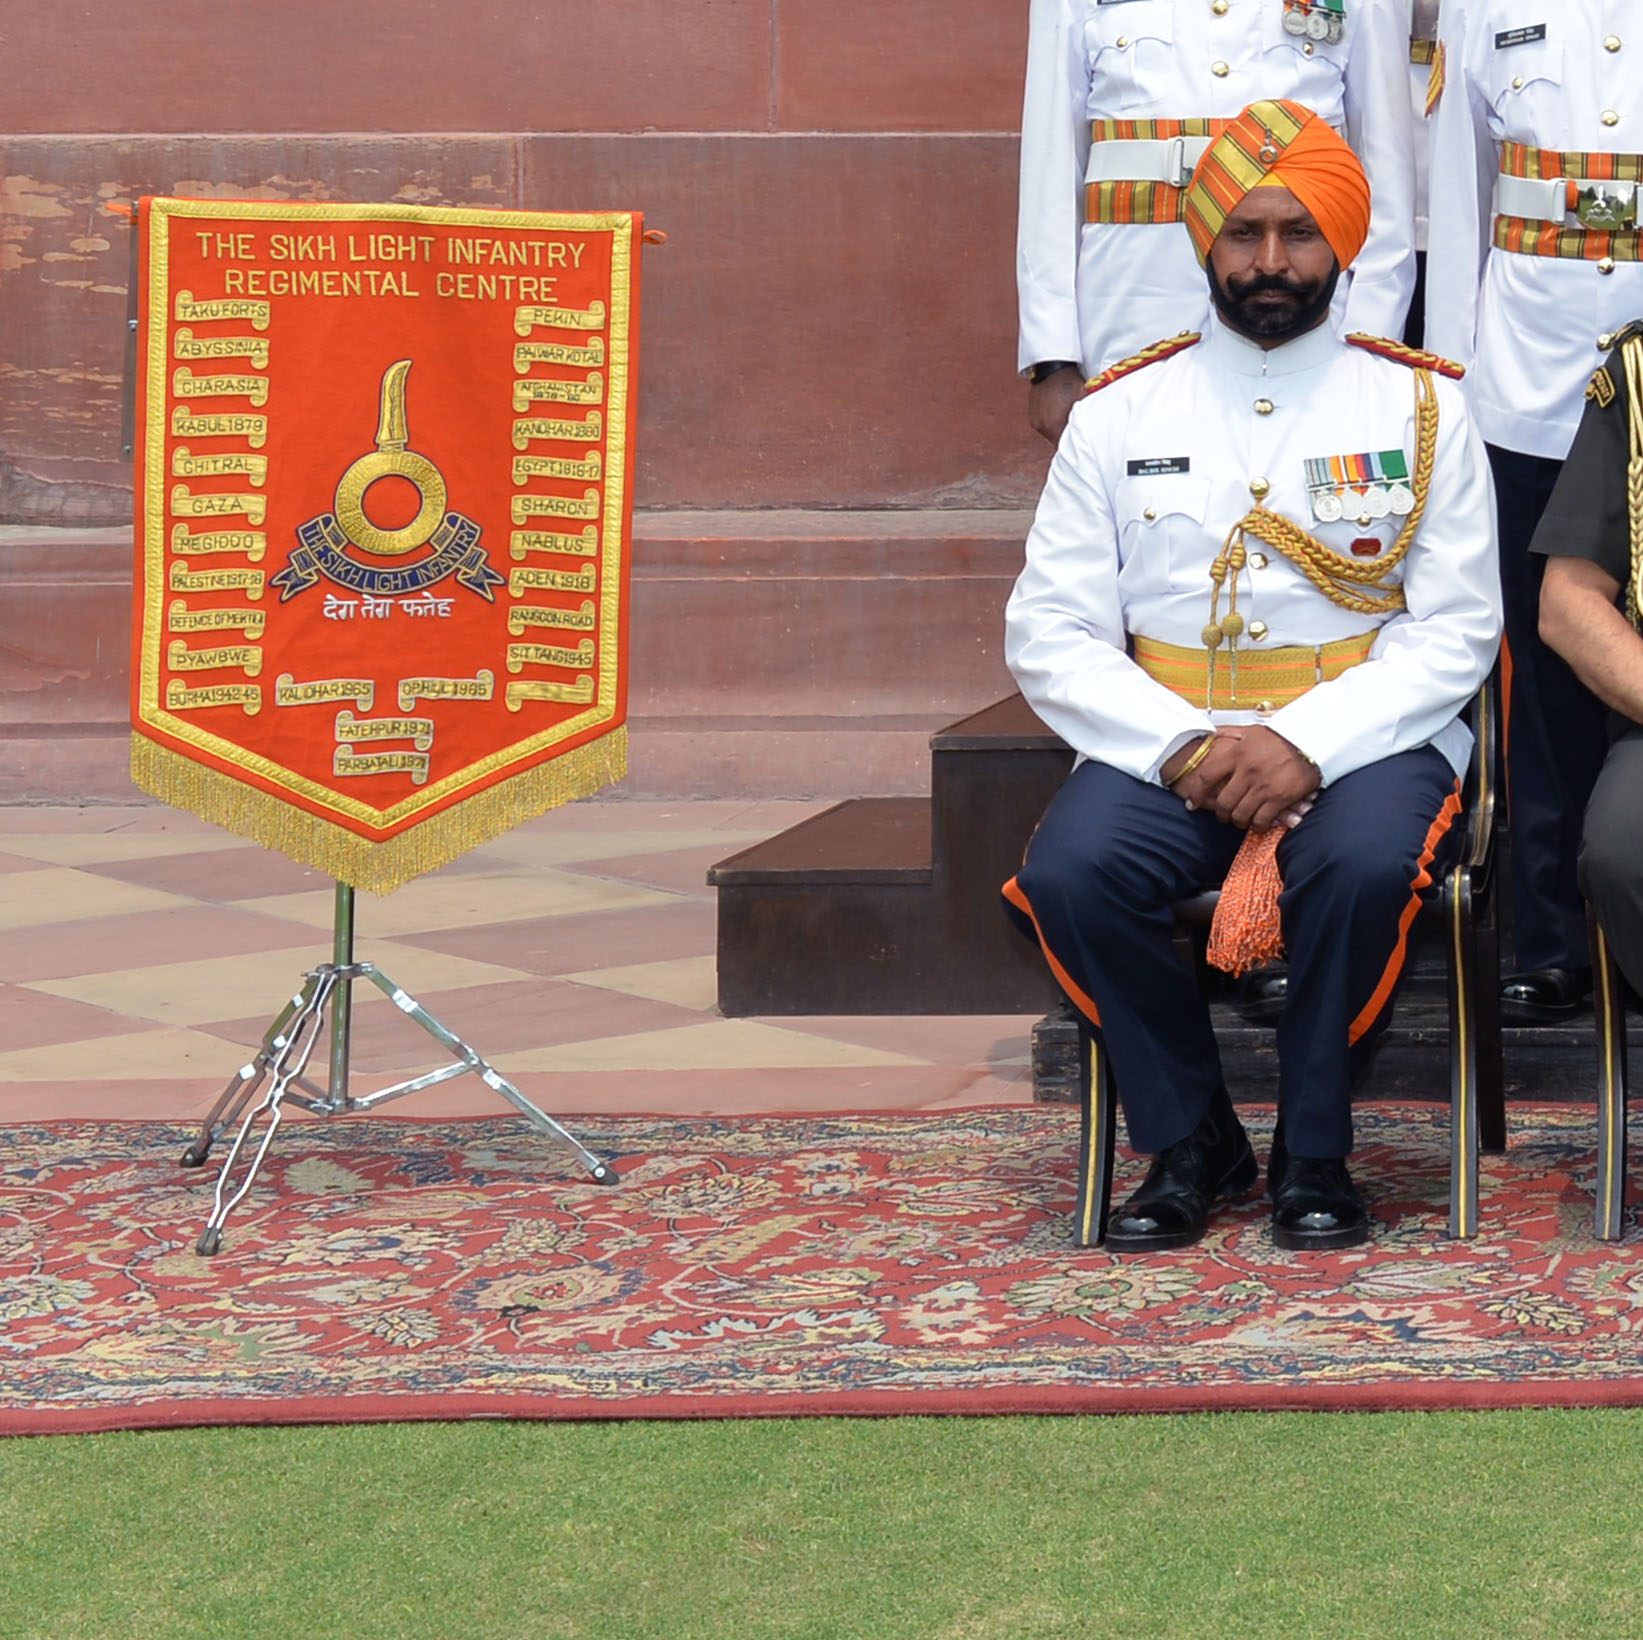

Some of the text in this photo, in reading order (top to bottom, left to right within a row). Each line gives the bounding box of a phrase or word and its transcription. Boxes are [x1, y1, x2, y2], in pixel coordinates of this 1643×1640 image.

[196, 232, 585, 268] THE SIKH LIGHT INFANTRY
[225, 269, 558, 302] REGIMENTAL CENTRE
[182, 303, 267, 318] TAKU FORTS
[534, 309, 581, 325] PEKIN
[180, 340, 263, 356] ABYSSINIA
[182, 379, 261, 394] CHARASIA
[176, 419, 263, 433] KABUL 1879
[515, 461, 558, 472] EGYPT
[192, 498, 243, 513] GAZA
[521, 498, 588, 515] SHARON
[180, 534, 254, 551] MEGIDDO
[521, 535, 584, 552] NABLUS
[305, 523, 476, 592] THE SIKH LIGHT INFANTRY
[515, 572, 555, 585] ADEN
[323, 591, 456, 620] देग तेग फतेह
[339, 721, 401, 736] FATEHPUR
